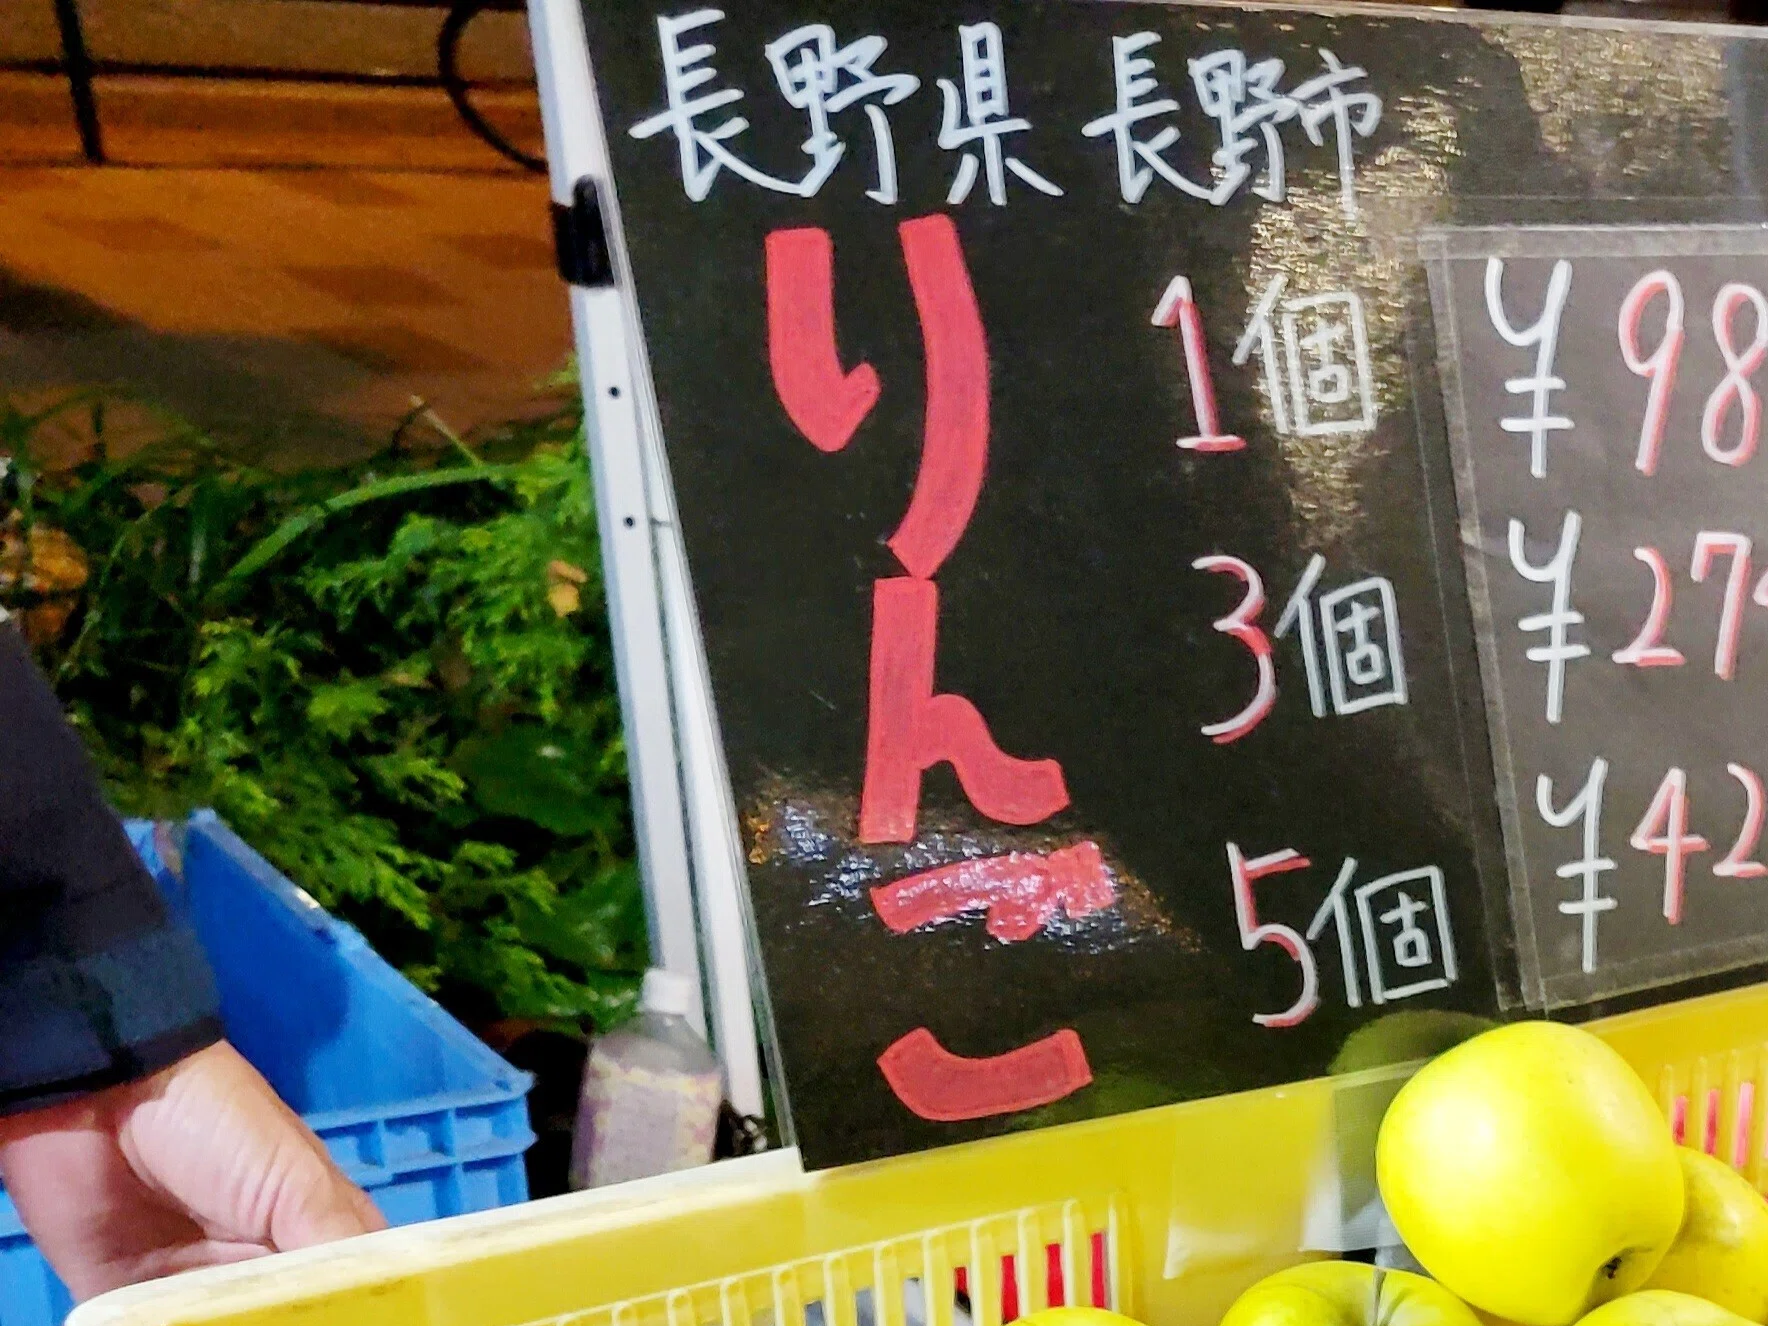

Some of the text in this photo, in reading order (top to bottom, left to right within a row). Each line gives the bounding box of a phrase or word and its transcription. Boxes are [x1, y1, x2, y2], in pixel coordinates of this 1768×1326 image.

[629, 9, 1382, 220] 長野県 長野市
[1151, 275, 1377, 453] 1個
[766, 214, 1115, 1122] りんご
[1191, 554, 1407, 743] 3個
[1224, 842, 1459, 1028] 5個
